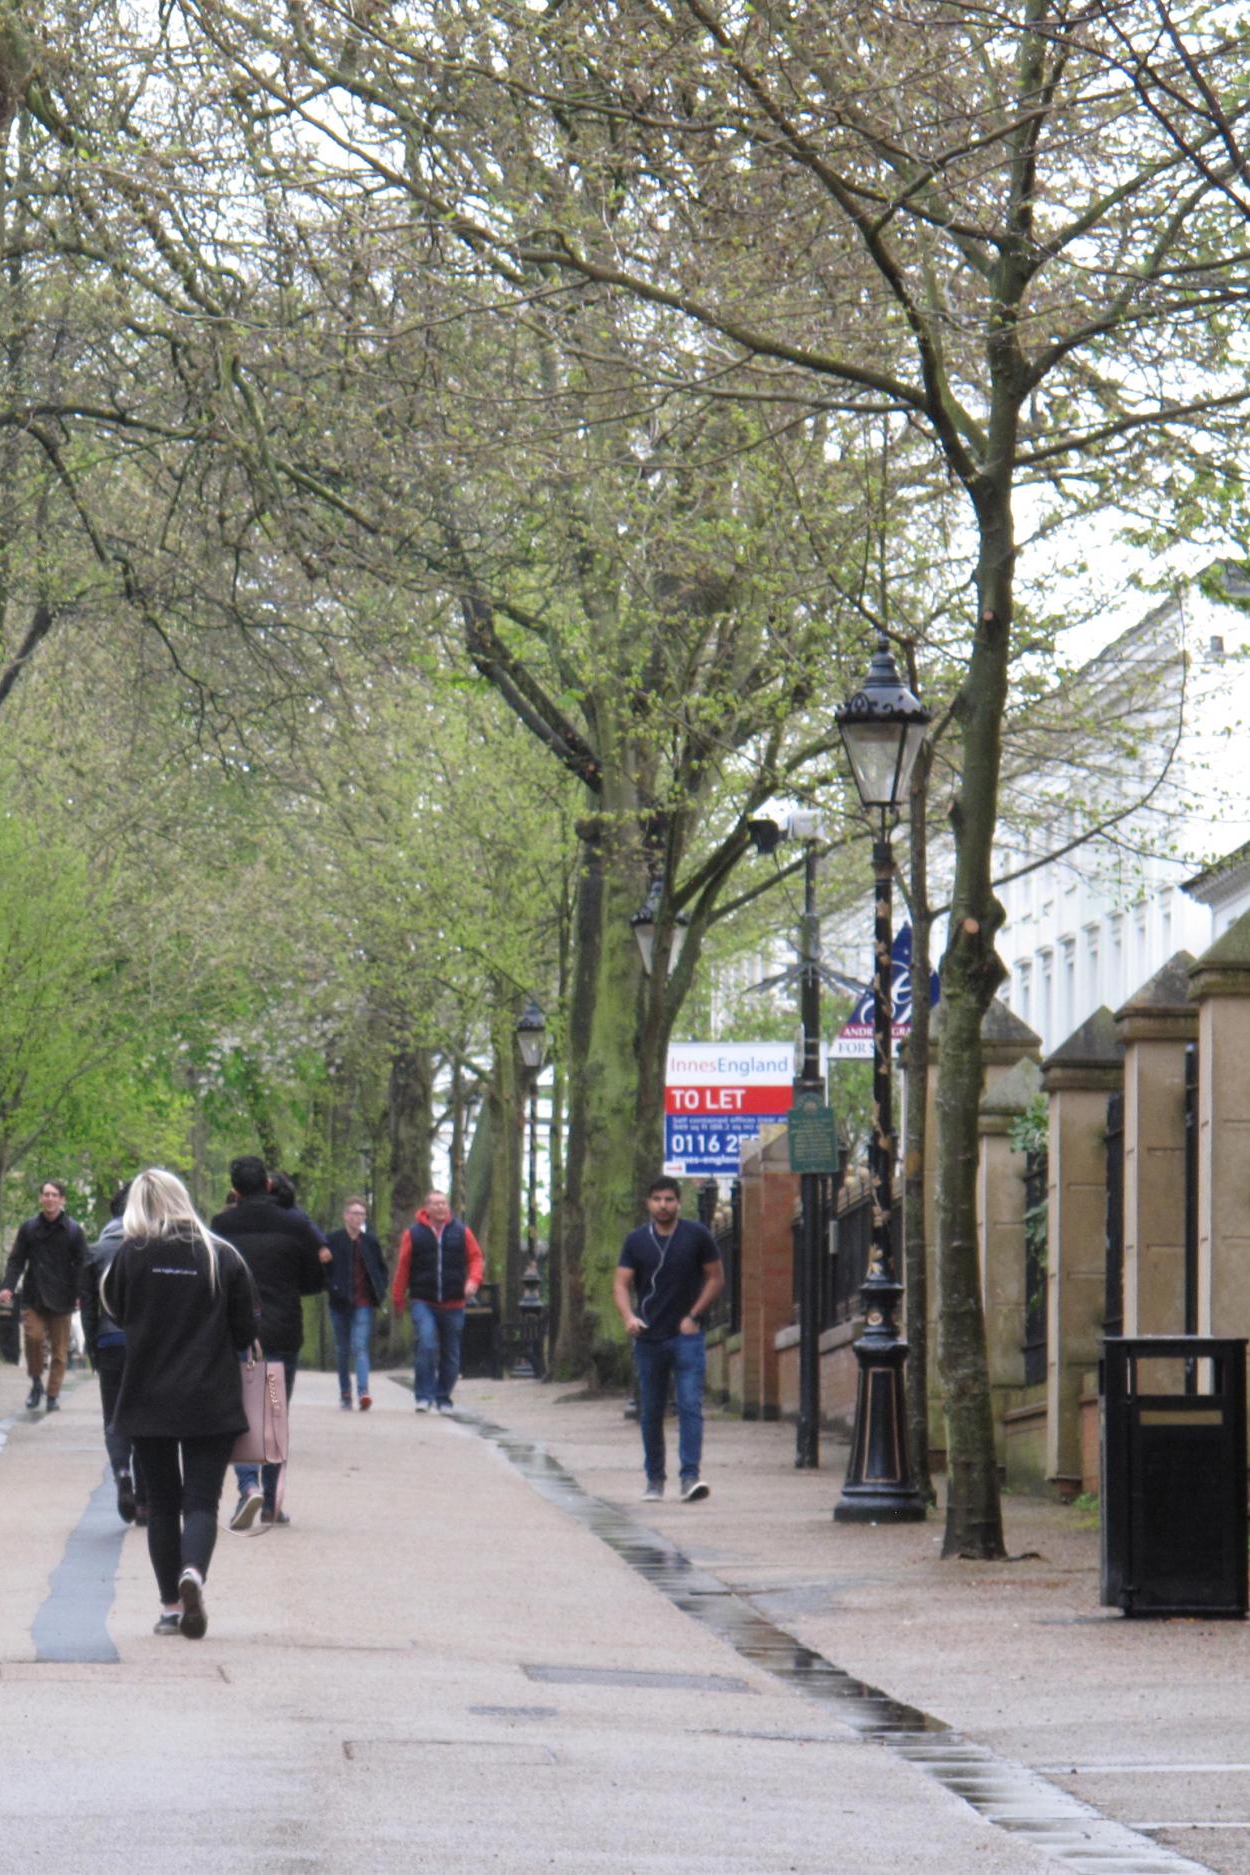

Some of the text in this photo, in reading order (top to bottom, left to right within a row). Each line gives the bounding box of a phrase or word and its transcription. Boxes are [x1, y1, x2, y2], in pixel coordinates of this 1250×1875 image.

[844, 1027, 875, 1037] ANDR
[838, 1042, 866, 1054] FOR
[671, 1056, 788, 1077] InnesEngland
[671, 1089, 746, 1110] TO LET
[671, 1134, 720, 1153] 0116
